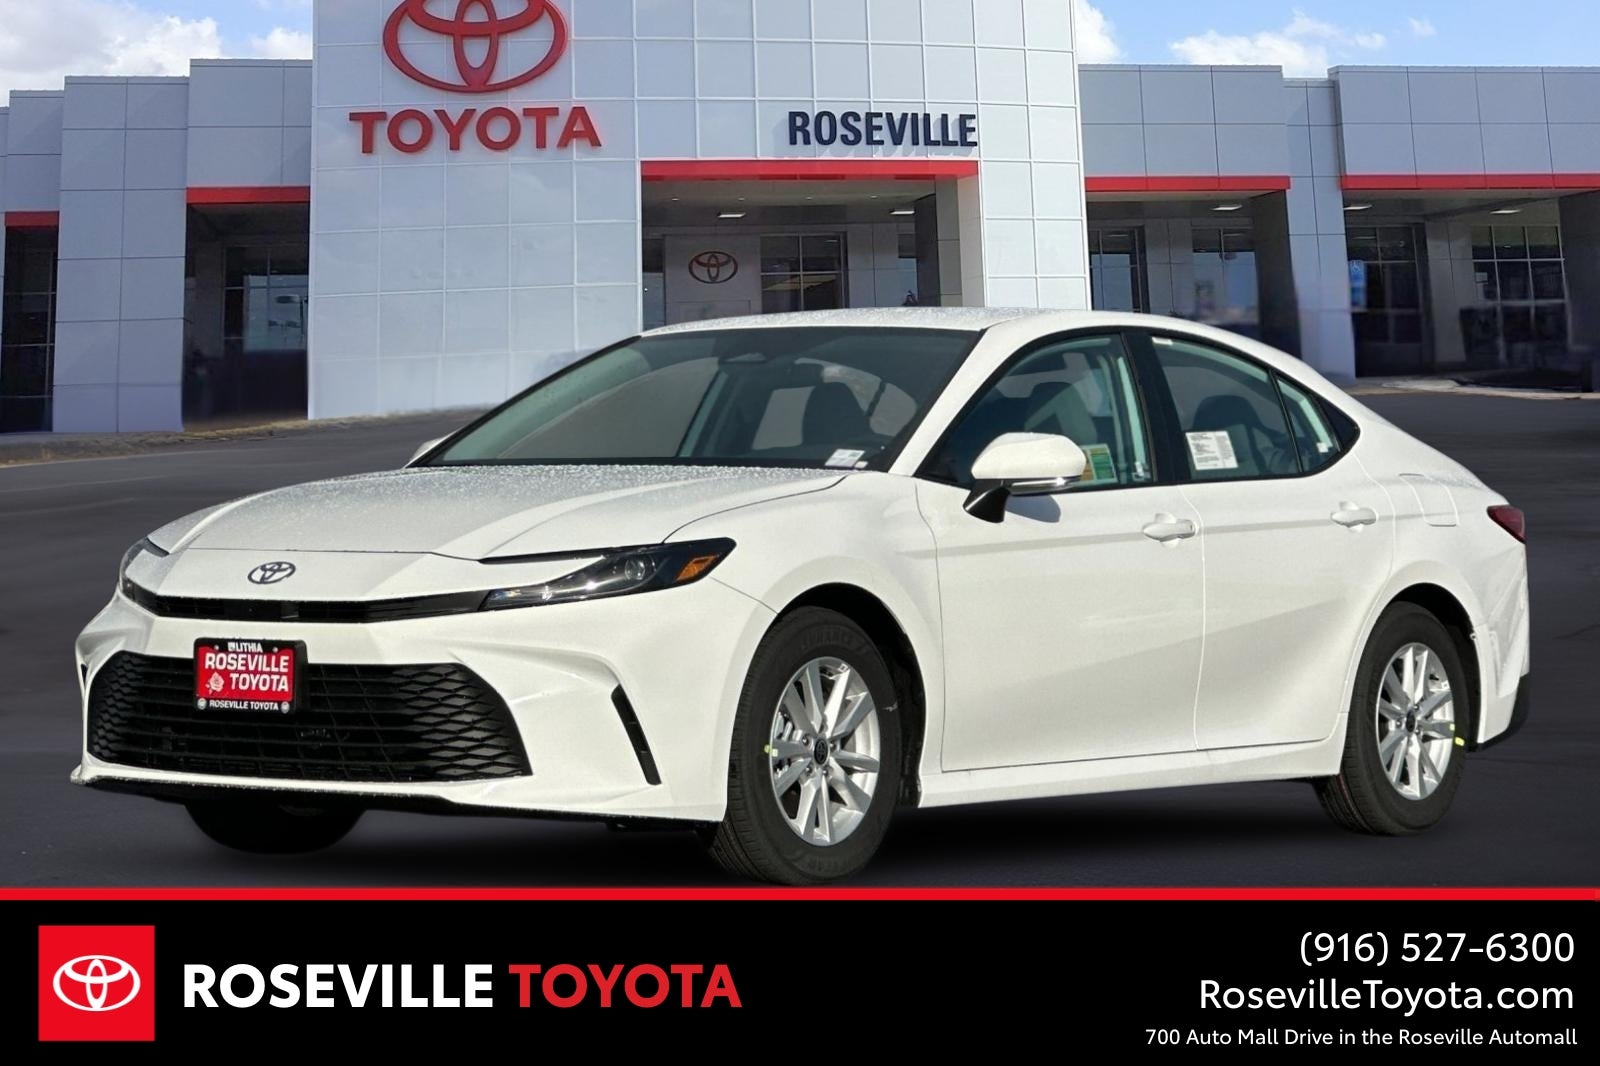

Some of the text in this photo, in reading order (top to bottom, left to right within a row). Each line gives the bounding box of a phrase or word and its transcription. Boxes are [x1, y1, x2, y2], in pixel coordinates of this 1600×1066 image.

[349, 106, 602, 154] TOYOTA
[788, 110, 979, 148] ROSEVILLE
[235, 642, 263, 653] LITHIA
[205, 652, 290, 672] ROSEVILLE
[229, 673, 289, 692] TOYOTA
[209, 700, 279, 711] ROSEVILLE TOYOTA
